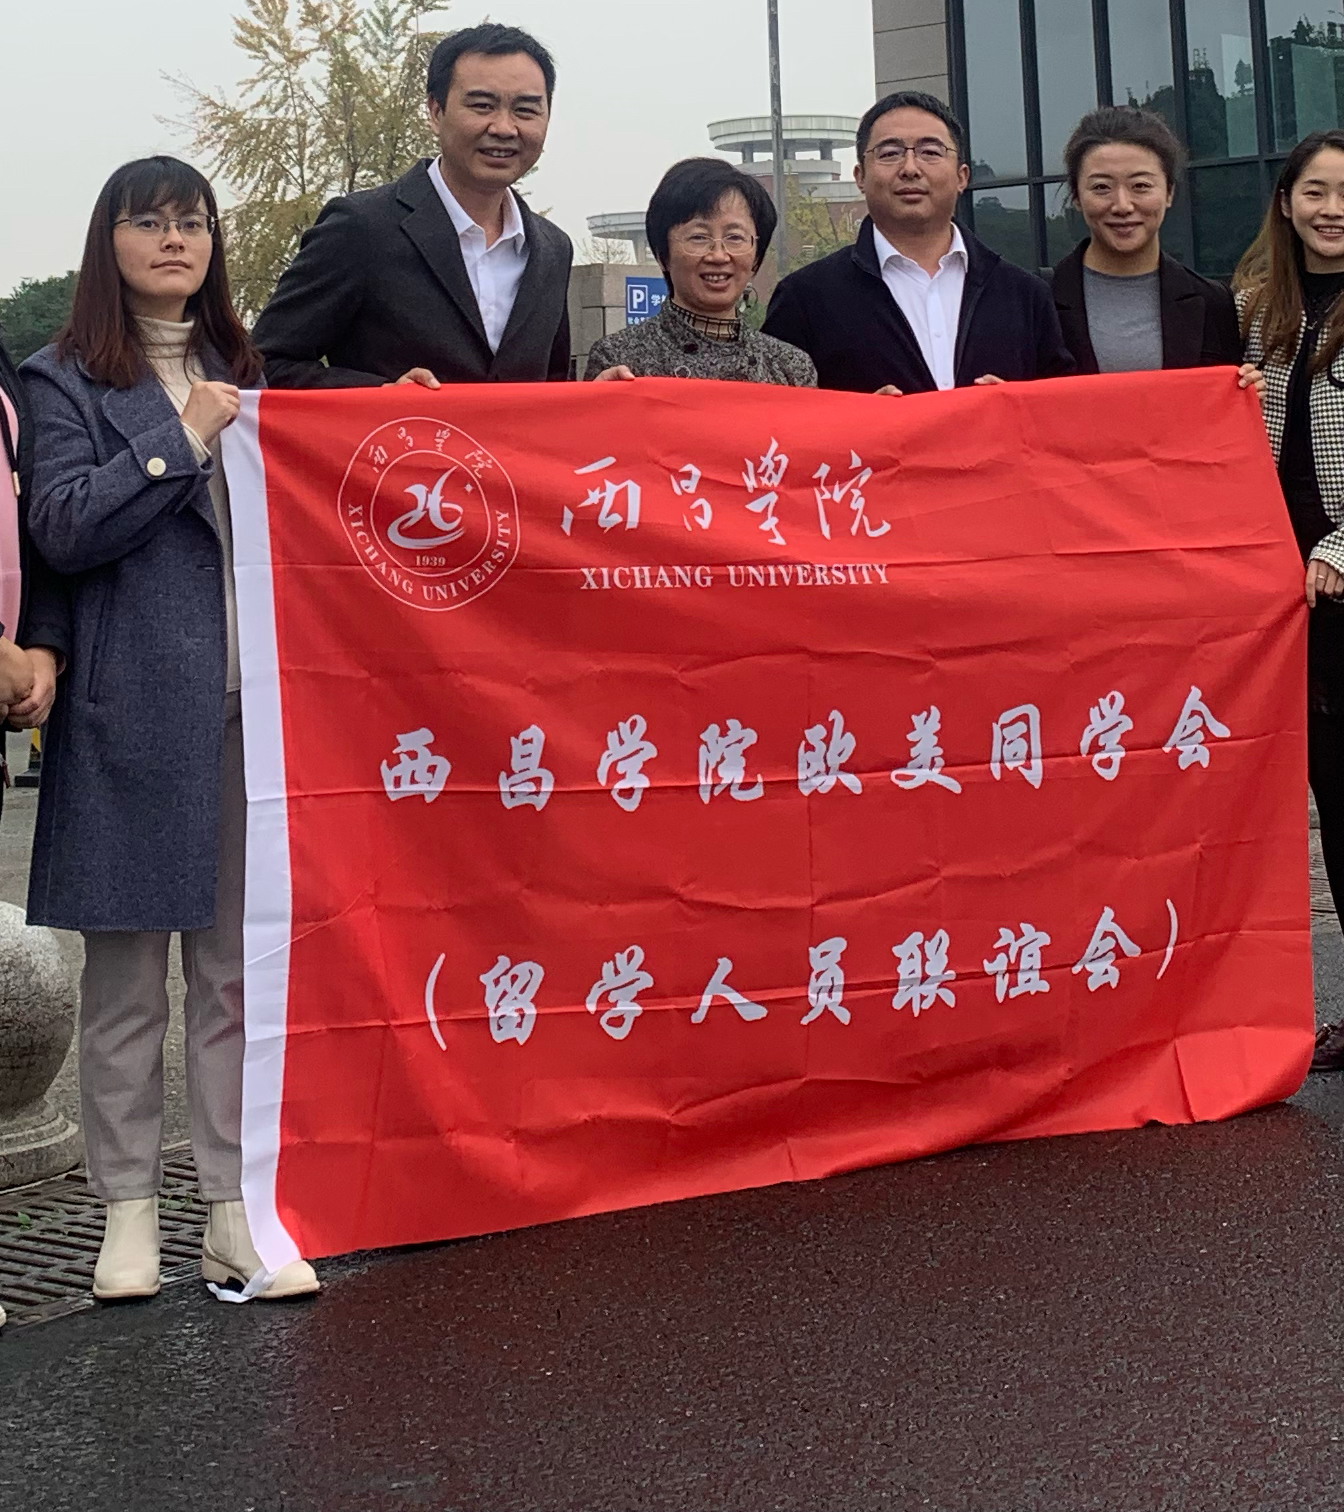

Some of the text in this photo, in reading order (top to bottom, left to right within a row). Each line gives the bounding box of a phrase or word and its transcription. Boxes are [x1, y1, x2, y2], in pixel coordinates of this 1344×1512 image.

[632, 289, 645, 309] P
[650, 294, 666, 306] 学
[347, 502, 512, 602] XICHANG UNIVERSITY
[414, 554, 447, 568] 1939
[579, 562, 891, 591] XICHANG UNIVERSITY
[379, 684, 1233, 813] 西昌学院欧美同学会
[423, 897, 1179, 1051] （留学人员联谊会）
